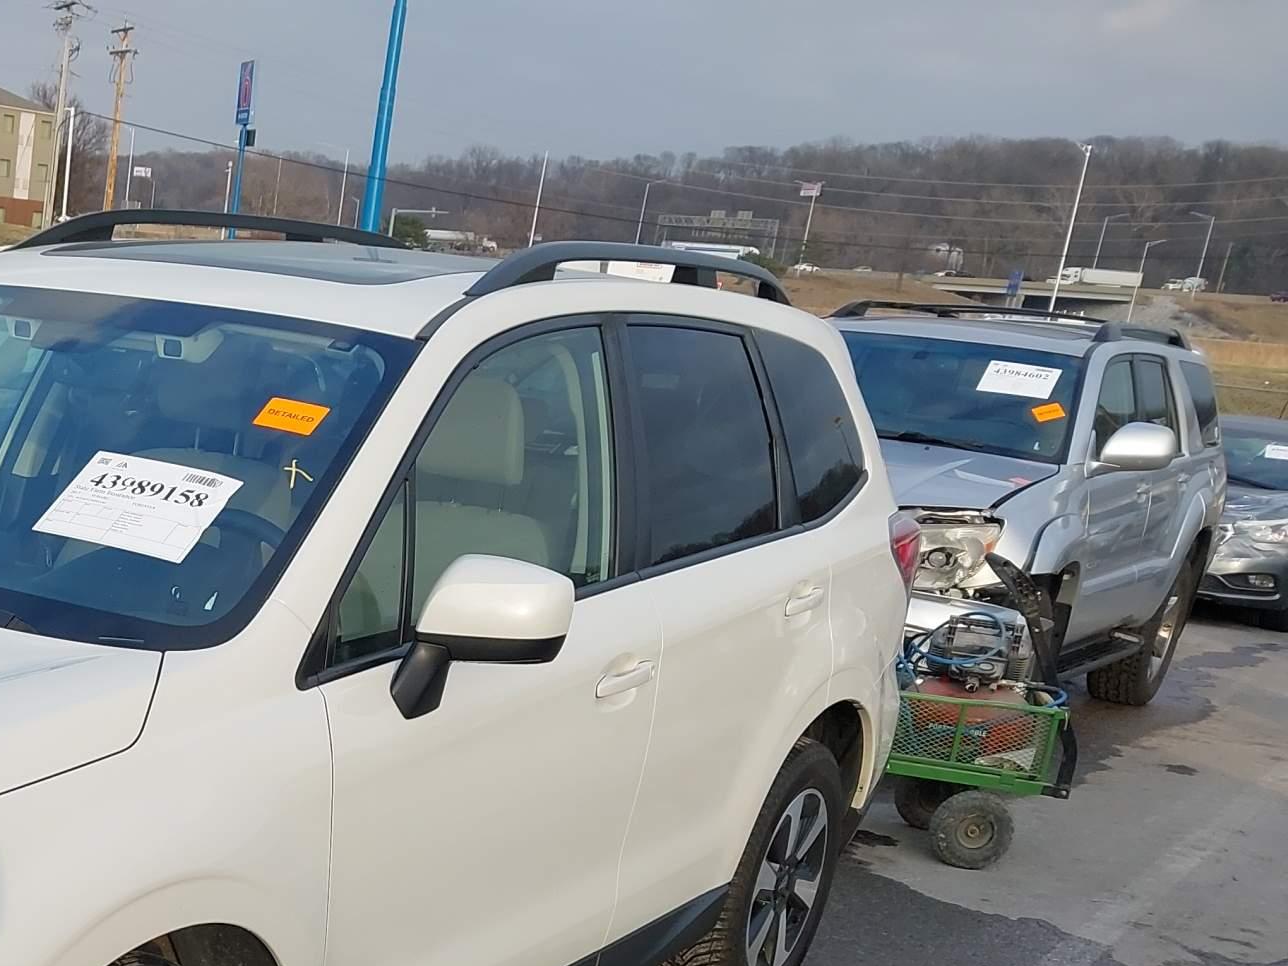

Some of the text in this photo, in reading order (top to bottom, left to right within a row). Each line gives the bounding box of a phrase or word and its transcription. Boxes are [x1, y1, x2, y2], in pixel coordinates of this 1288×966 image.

[993, 367, 1051, 380] 43984602
[267, 408, 315, 423] DETAILED
[90, 472, 209, 508] 43989158
